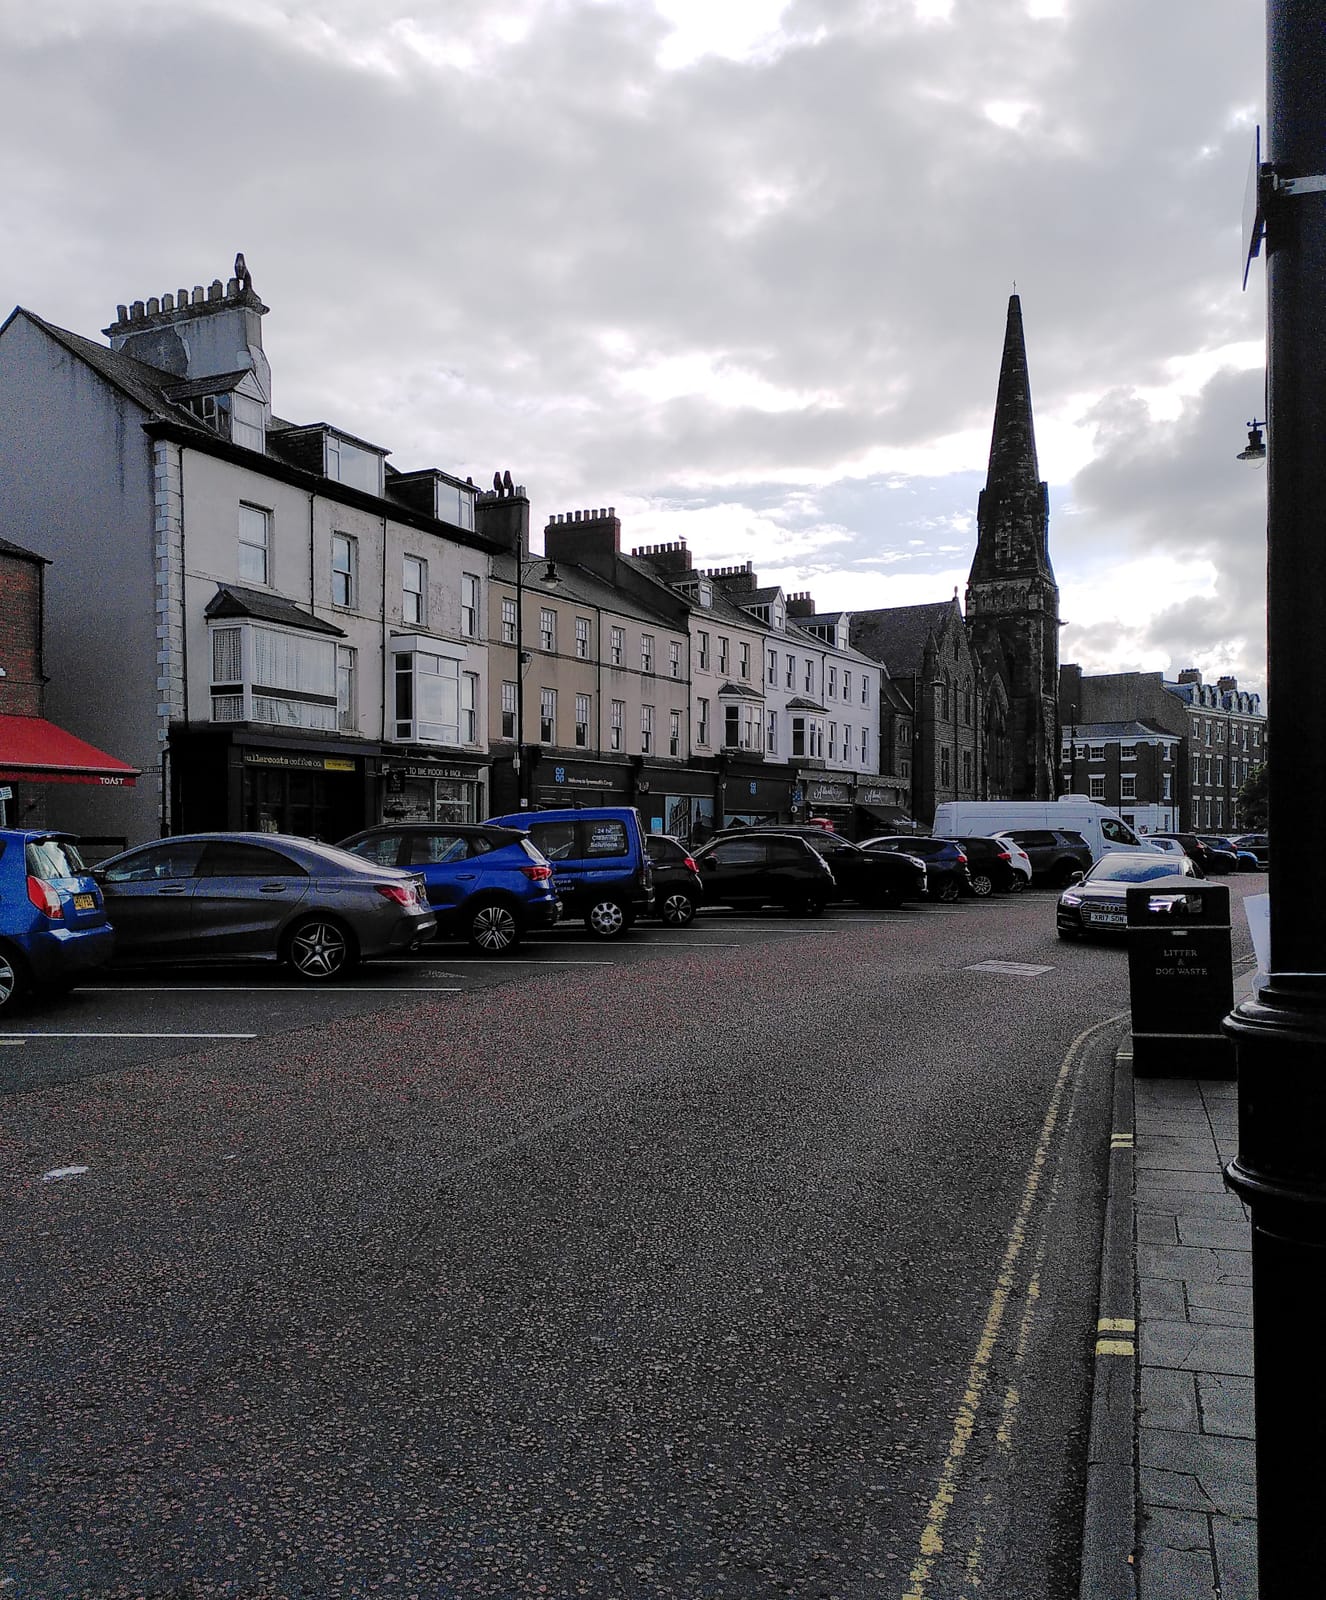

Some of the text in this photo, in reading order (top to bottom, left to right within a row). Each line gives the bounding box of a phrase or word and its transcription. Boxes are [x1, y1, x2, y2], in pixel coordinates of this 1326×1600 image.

[99, 777, 125, 785] TOAST
[1163, 949, 1198, 957] LITTER
[1155, 967, 1208, 976] DOG WASTE
